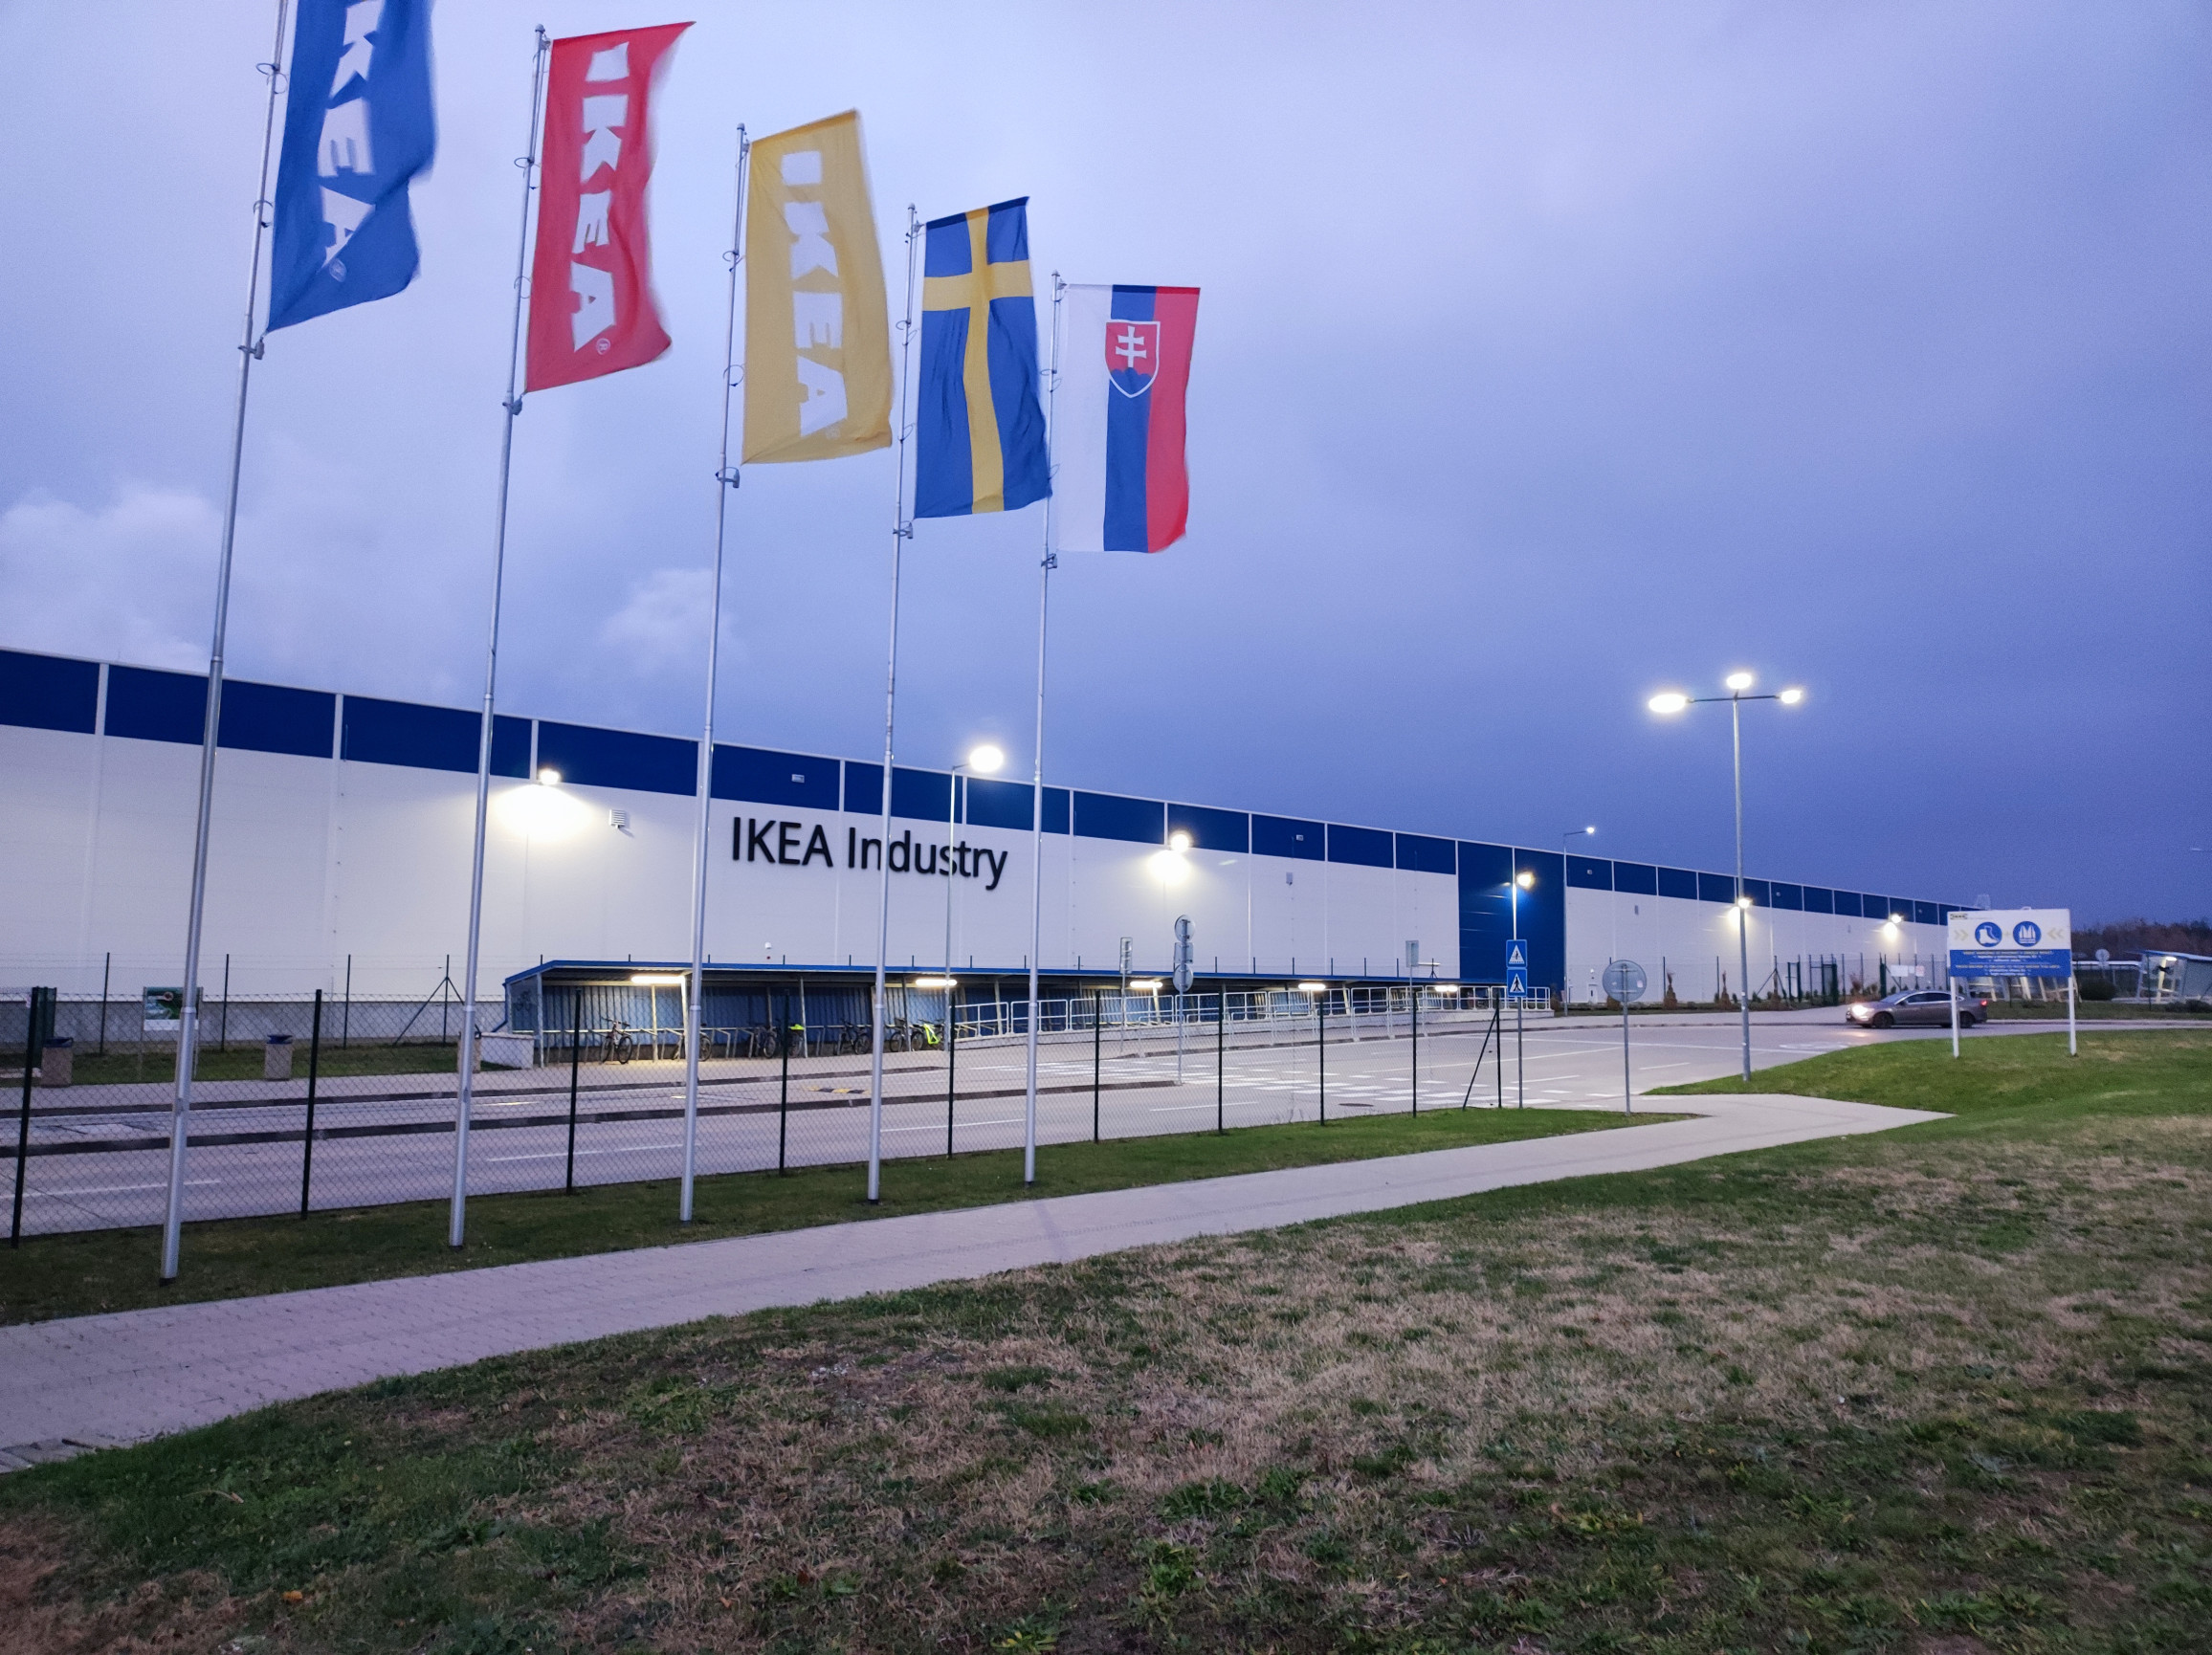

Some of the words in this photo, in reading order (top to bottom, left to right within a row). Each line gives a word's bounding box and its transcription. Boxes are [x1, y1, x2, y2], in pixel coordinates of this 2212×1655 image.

[316, 0, 383, 272] KEA
[571, 42, 630, 352] IKEA
[781, 150, 848, 437] IKEA
[732, 817, 833, 868] IKEA
[849, 827, 1008, 891] Industry
